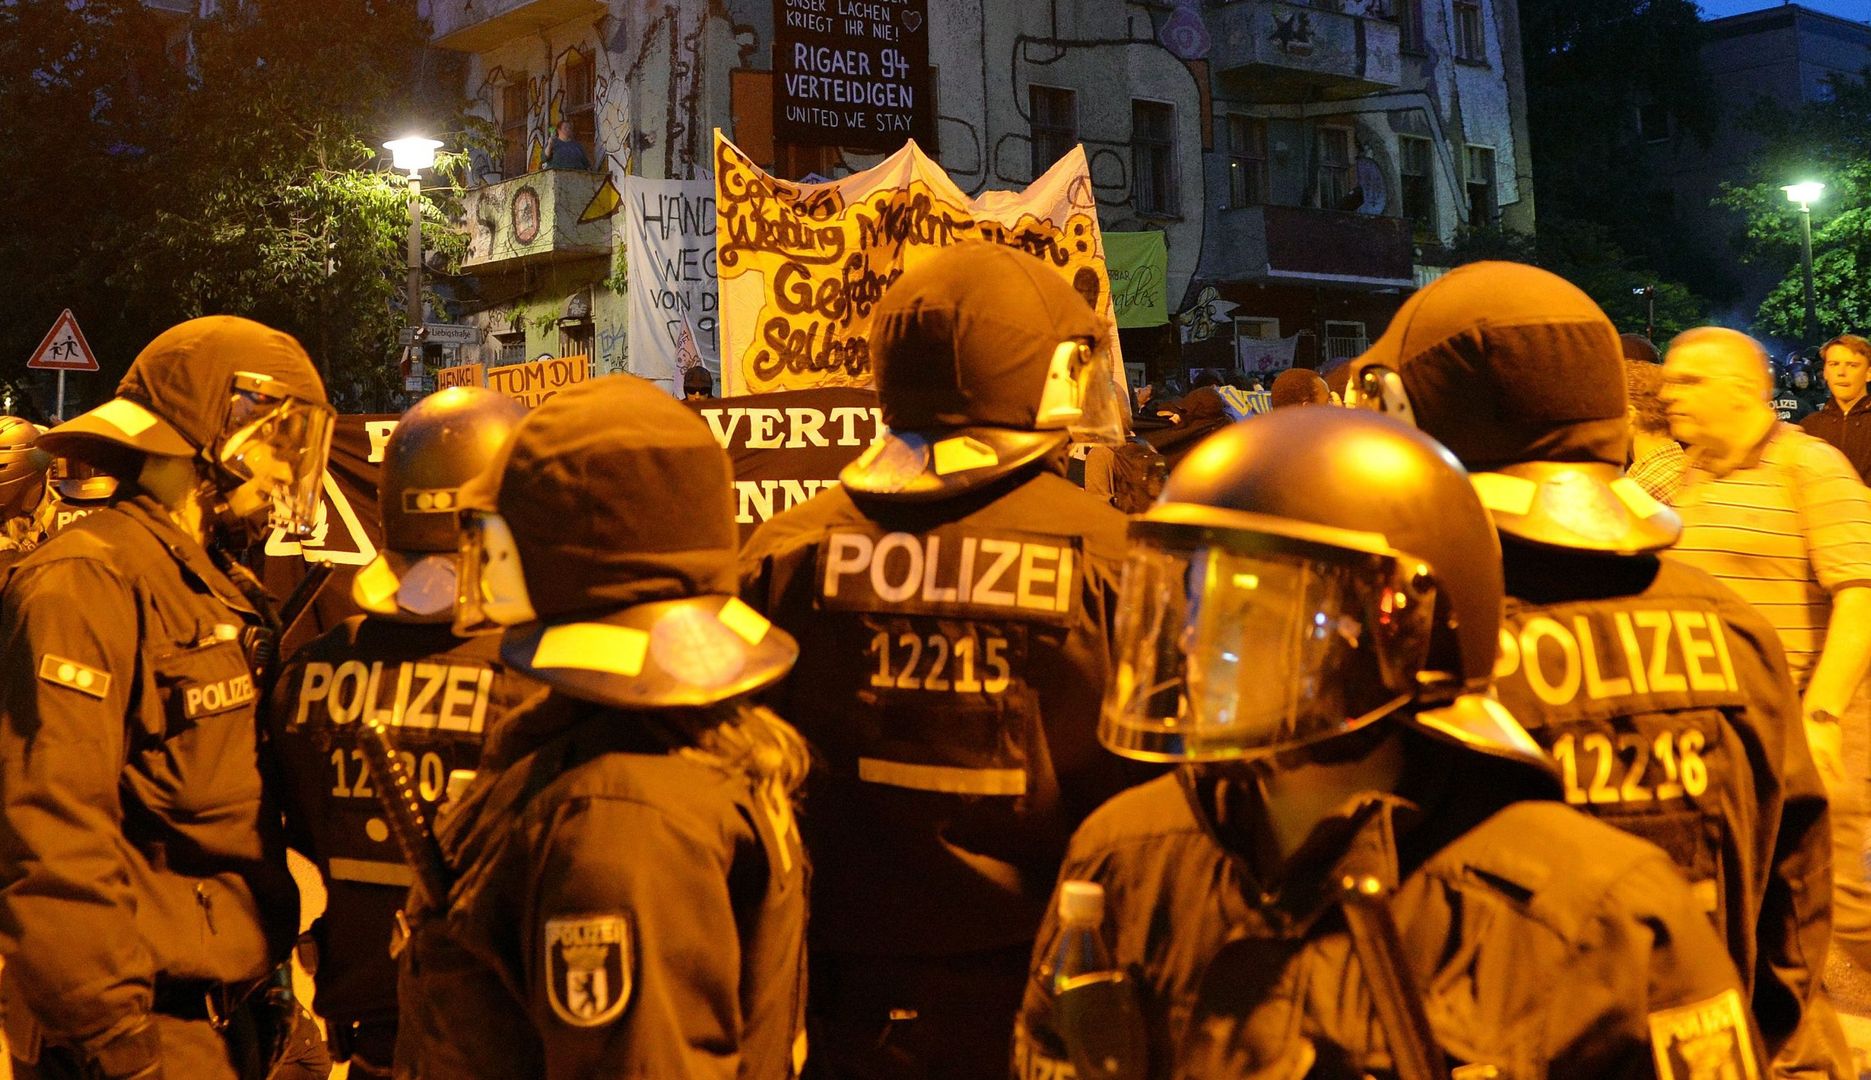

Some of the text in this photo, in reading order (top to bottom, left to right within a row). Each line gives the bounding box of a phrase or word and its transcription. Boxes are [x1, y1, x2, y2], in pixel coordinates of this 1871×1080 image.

[786, 10, 899, 42] KRIEGT IHR NIE!
[838, 0, 890, 21] LACHEN
[794, 42, 910, 80] RIGAER 94
[785, 72, 913, 109] VERTEIDIGEN
[786, 105, 913, 132] UNITED WE STAY
[642, 191, 717, 241] HÄND
[654, 248, 718, 281] WEG
[650, 288, 691, 312] VON
[488, 363, 545, 394] TOM
[549, 360, 585, 387] DU
[1767, 399, 1798, 410] OLIZEI
[824, 532, 1074, 613] POLIZEI
[870, 632, 1010, 694] 12215
[186, 674, 255, 716] POLIZE
[296, 660, 494, 733] POLIZEI
[331, 747, 444, 802] 120
[1552, 728, 1708, 805] 12216
